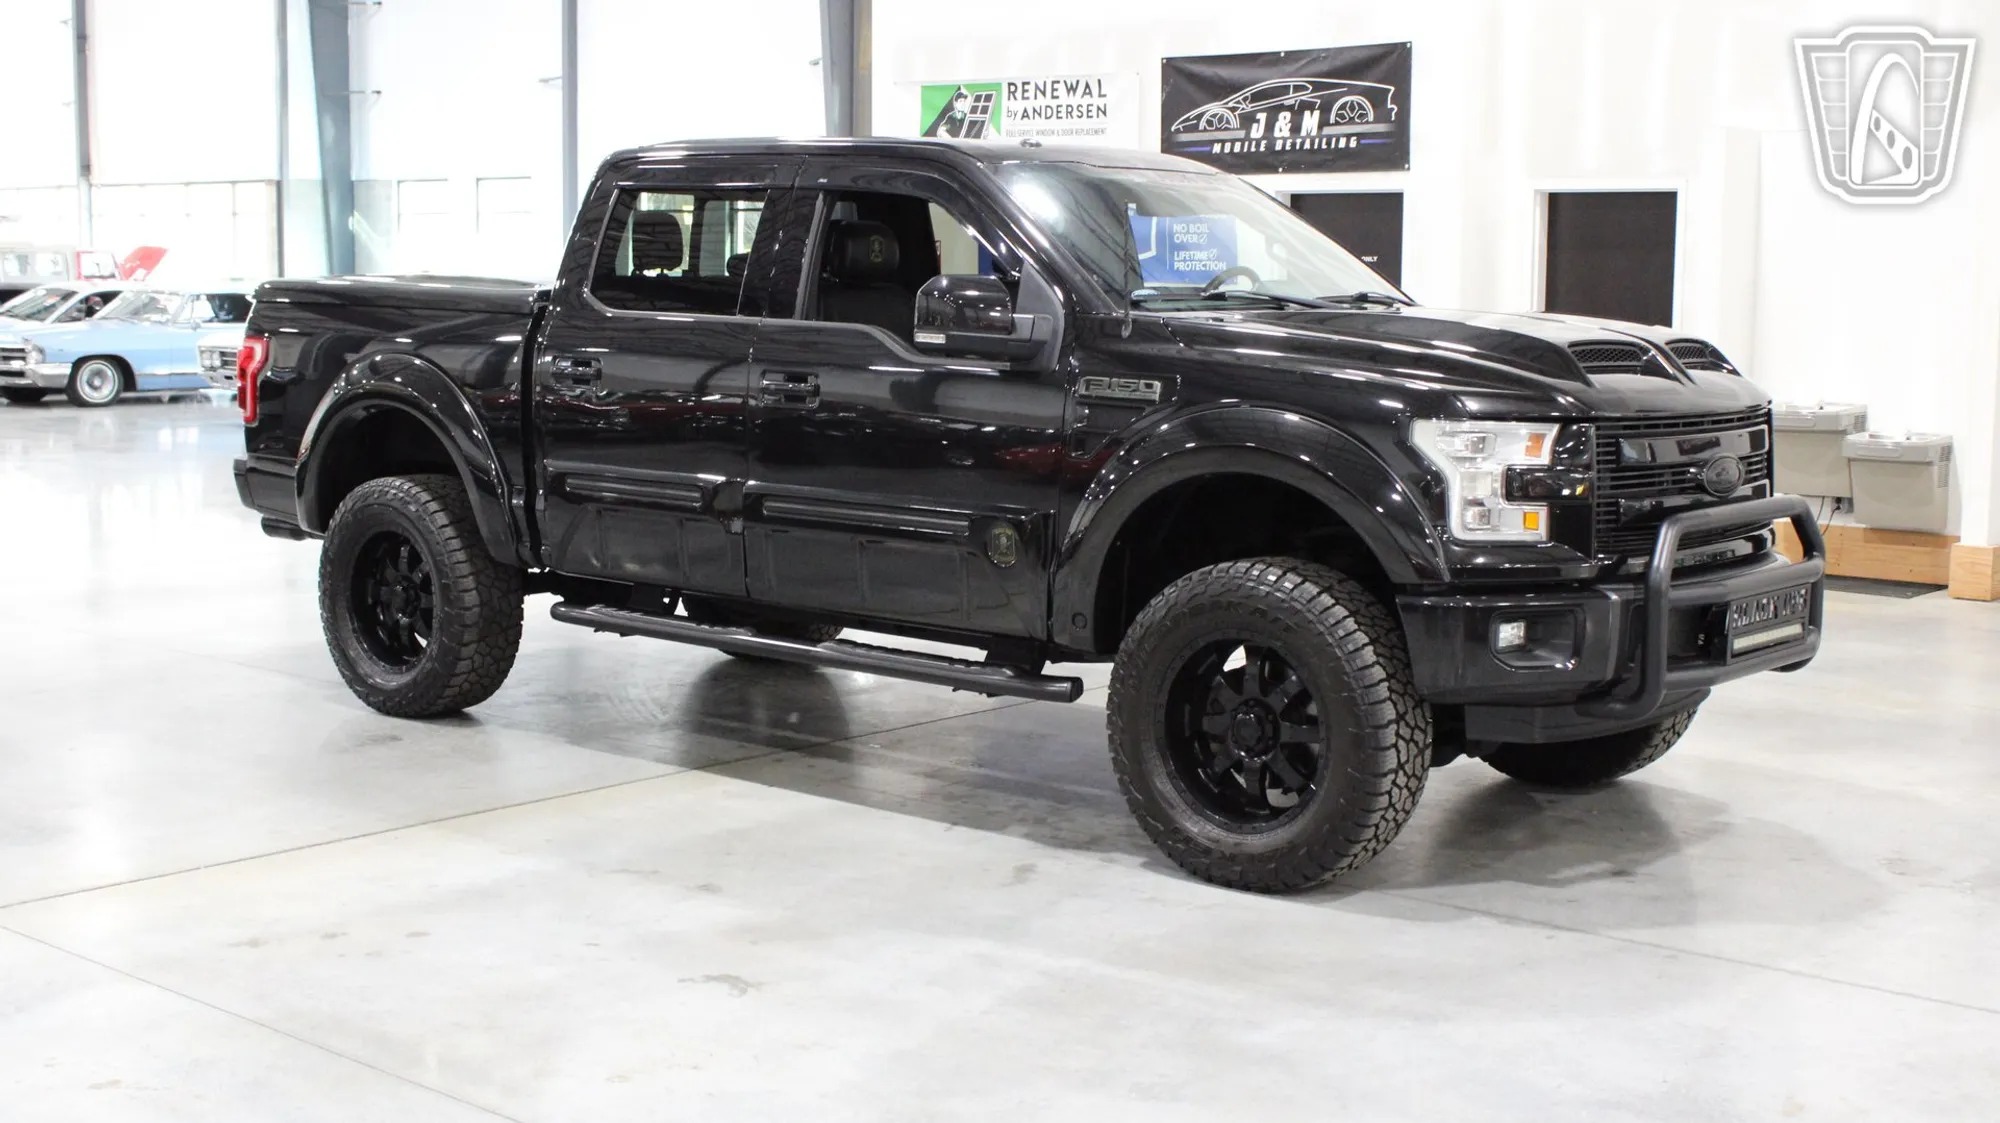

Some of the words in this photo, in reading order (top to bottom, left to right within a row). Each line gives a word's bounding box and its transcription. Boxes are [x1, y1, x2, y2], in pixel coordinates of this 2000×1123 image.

[1007, 79, 1107, 101] RENEWAL
[1006, 106, 1018, 121] by
[1021, 103, 1107, 120] ANDERSEN
[1250, 112, 1267, 138] J
[1274, 112, 1292, 137] &
[1301, 110, 1320, 137] M
[1212, 140, 1267, 154] MOBILE
[1275, 137, 1358, 150] DETAILING
[1173, 224, 1187, 233] NO
[1189, 224, 1210, 233] BOIL
[1173, 233, 1198, 243] OVER
[1174, 251, 1208, 260] LIFETIME
[1174, 261, 1226, 271] PROTECTION
